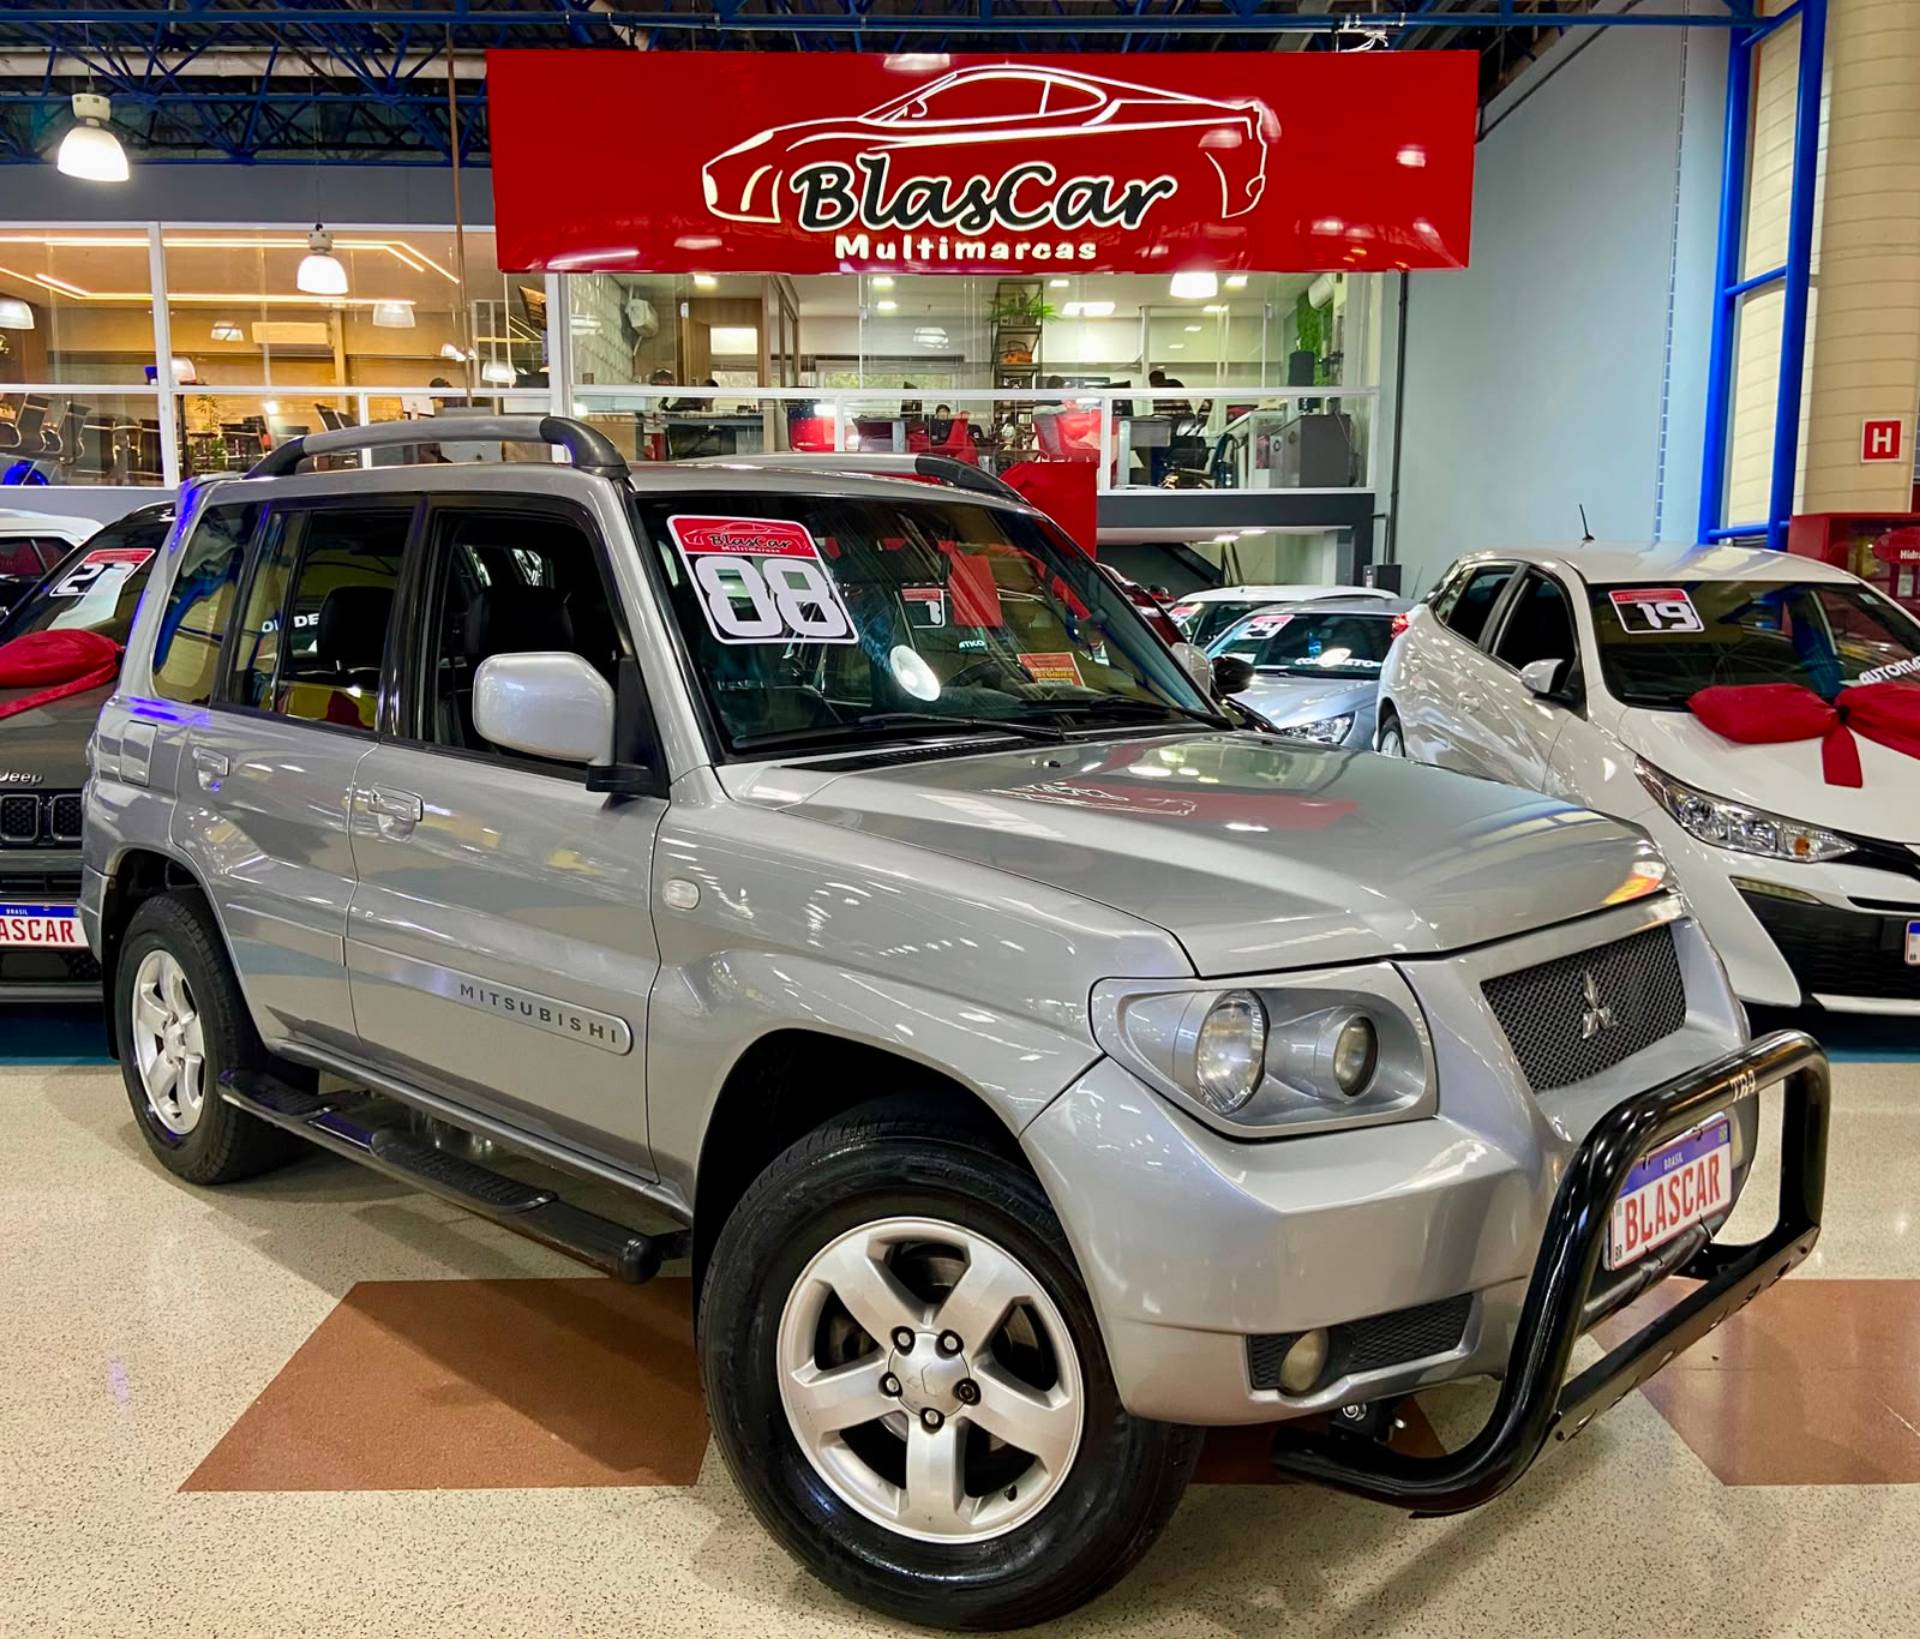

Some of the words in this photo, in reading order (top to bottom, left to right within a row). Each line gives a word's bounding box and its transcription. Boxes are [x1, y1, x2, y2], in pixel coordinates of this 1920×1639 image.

[790, 152, 1178, 235] BlasCar
[835, 234, 1097, 260] Multimarcas
[1872, 427, 1892, 453] H
[708, 533, 793, 549] BlasCar
[1900, 548, 1920, 560] Hidr
[1637, 601, 1699, 630] 19
[0, 771, 44, 787] Jeep
[6, 908, 28, 916] BRASIL
[460, 983, 616, 1043] MITSUBISHI
[1663, 1151, 1684, 1171] BRASIL
[1624, 1153, 1721, 1251] BLASCAR
